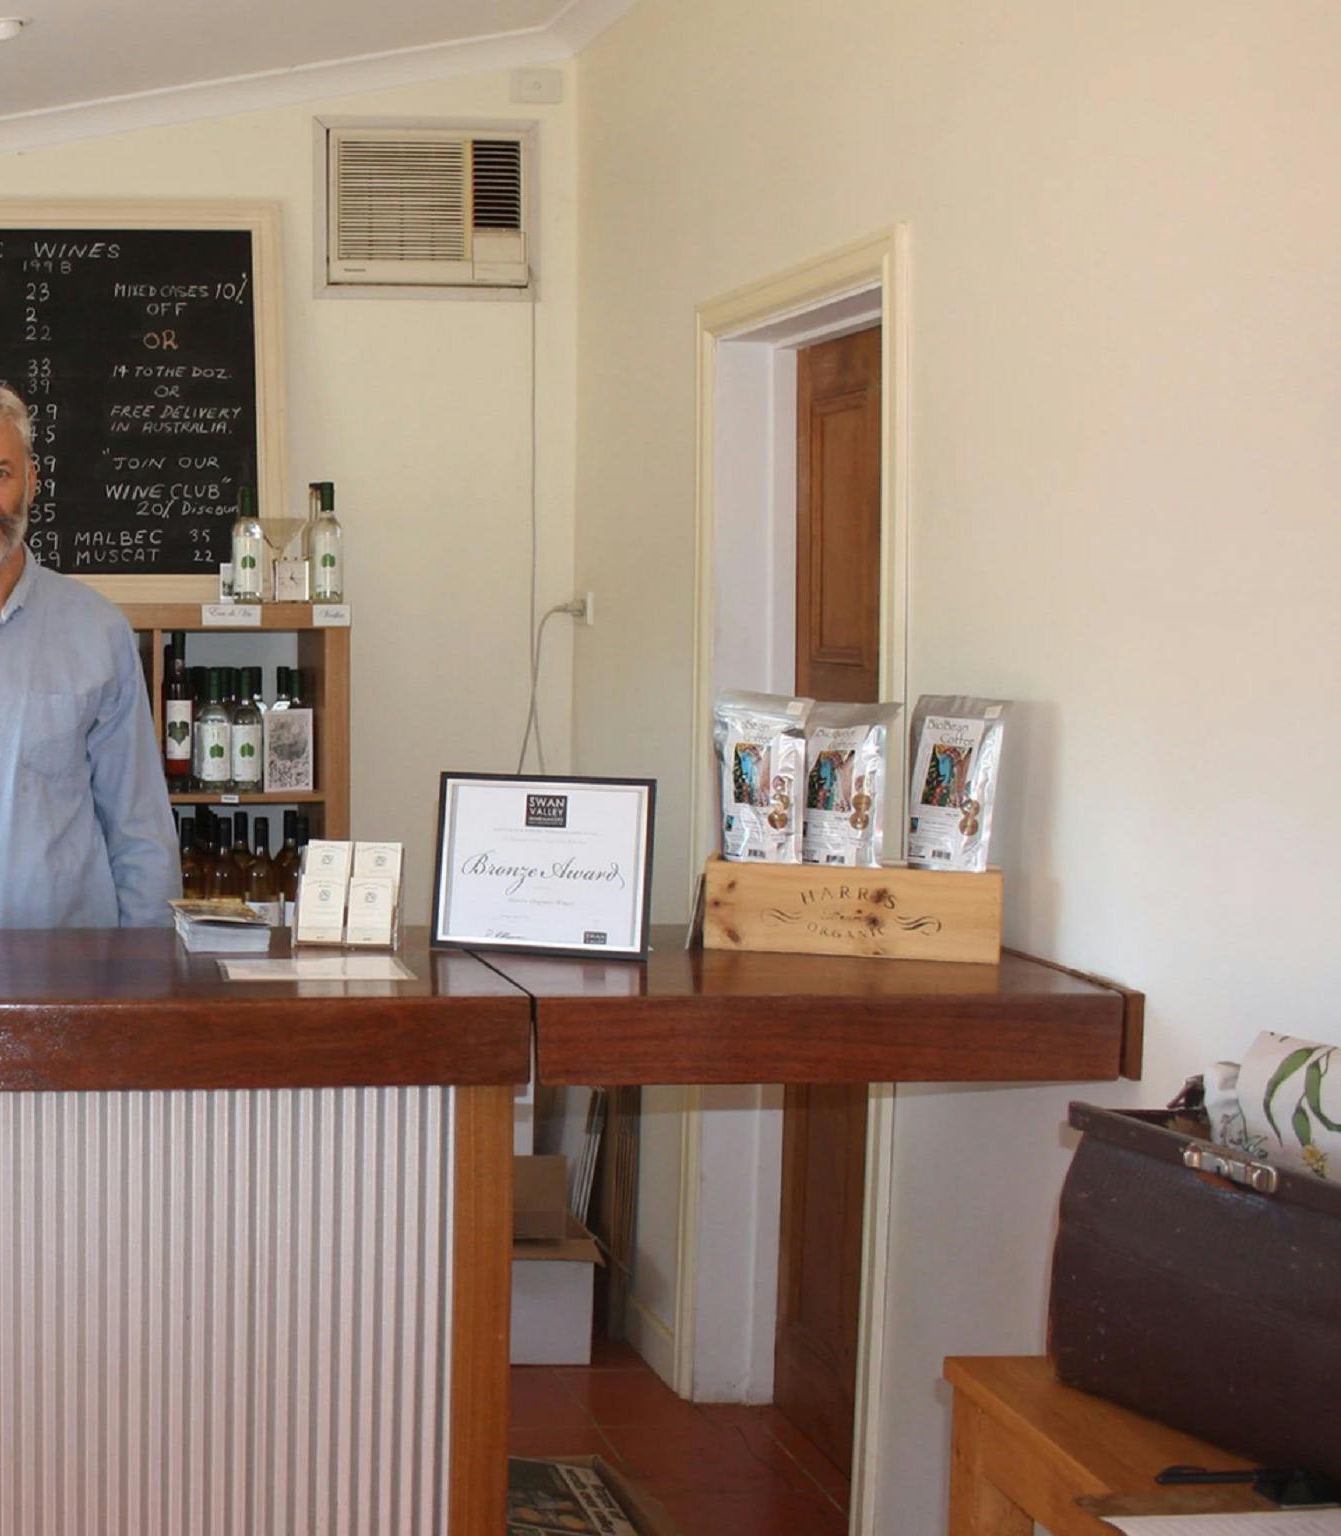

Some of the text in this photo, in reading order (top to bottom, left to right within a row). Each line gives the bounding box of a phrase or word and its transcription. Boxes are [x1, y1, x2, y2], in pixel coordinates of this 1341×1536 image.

[33, 241, 121, 260] WINES
[23, 261, 72, 275] 1998
[26, 282, 51, 302] 23
[159, 283, 209, 298] CASES
[146, 302, 188, 316] OFF
[26, 325, 52, 341] 22
[143, 329, 179, 351] OR
[28, 358, 52, 379] 33
[134, 366, 154, 378] TO
[156, 365, 186, 378] THE
[28, 378, 51, 395] 39
[154, 385, 180, 398] OR
[28, 403, 58, 421] 29
[111, 405, 241, 419] FREE DELIVERY
[111, 421, 130, 432] IN
[178, 457, 220, 470] OUR
[105, 483, 166, 499] WINE
[30, 502, 56, 523] 35
[136, 499, 175, 519] 20%
[29, 530, 59, 551] 69
[73, 528, 211, 547] MALBEC 35
[75, 547, 215, 566] MUSCAT 22
[529, 796, 565, 808] SWAN
[529, 808, 564, 817] VALLEY
[461, 849, 626, 896] Bronze Award
